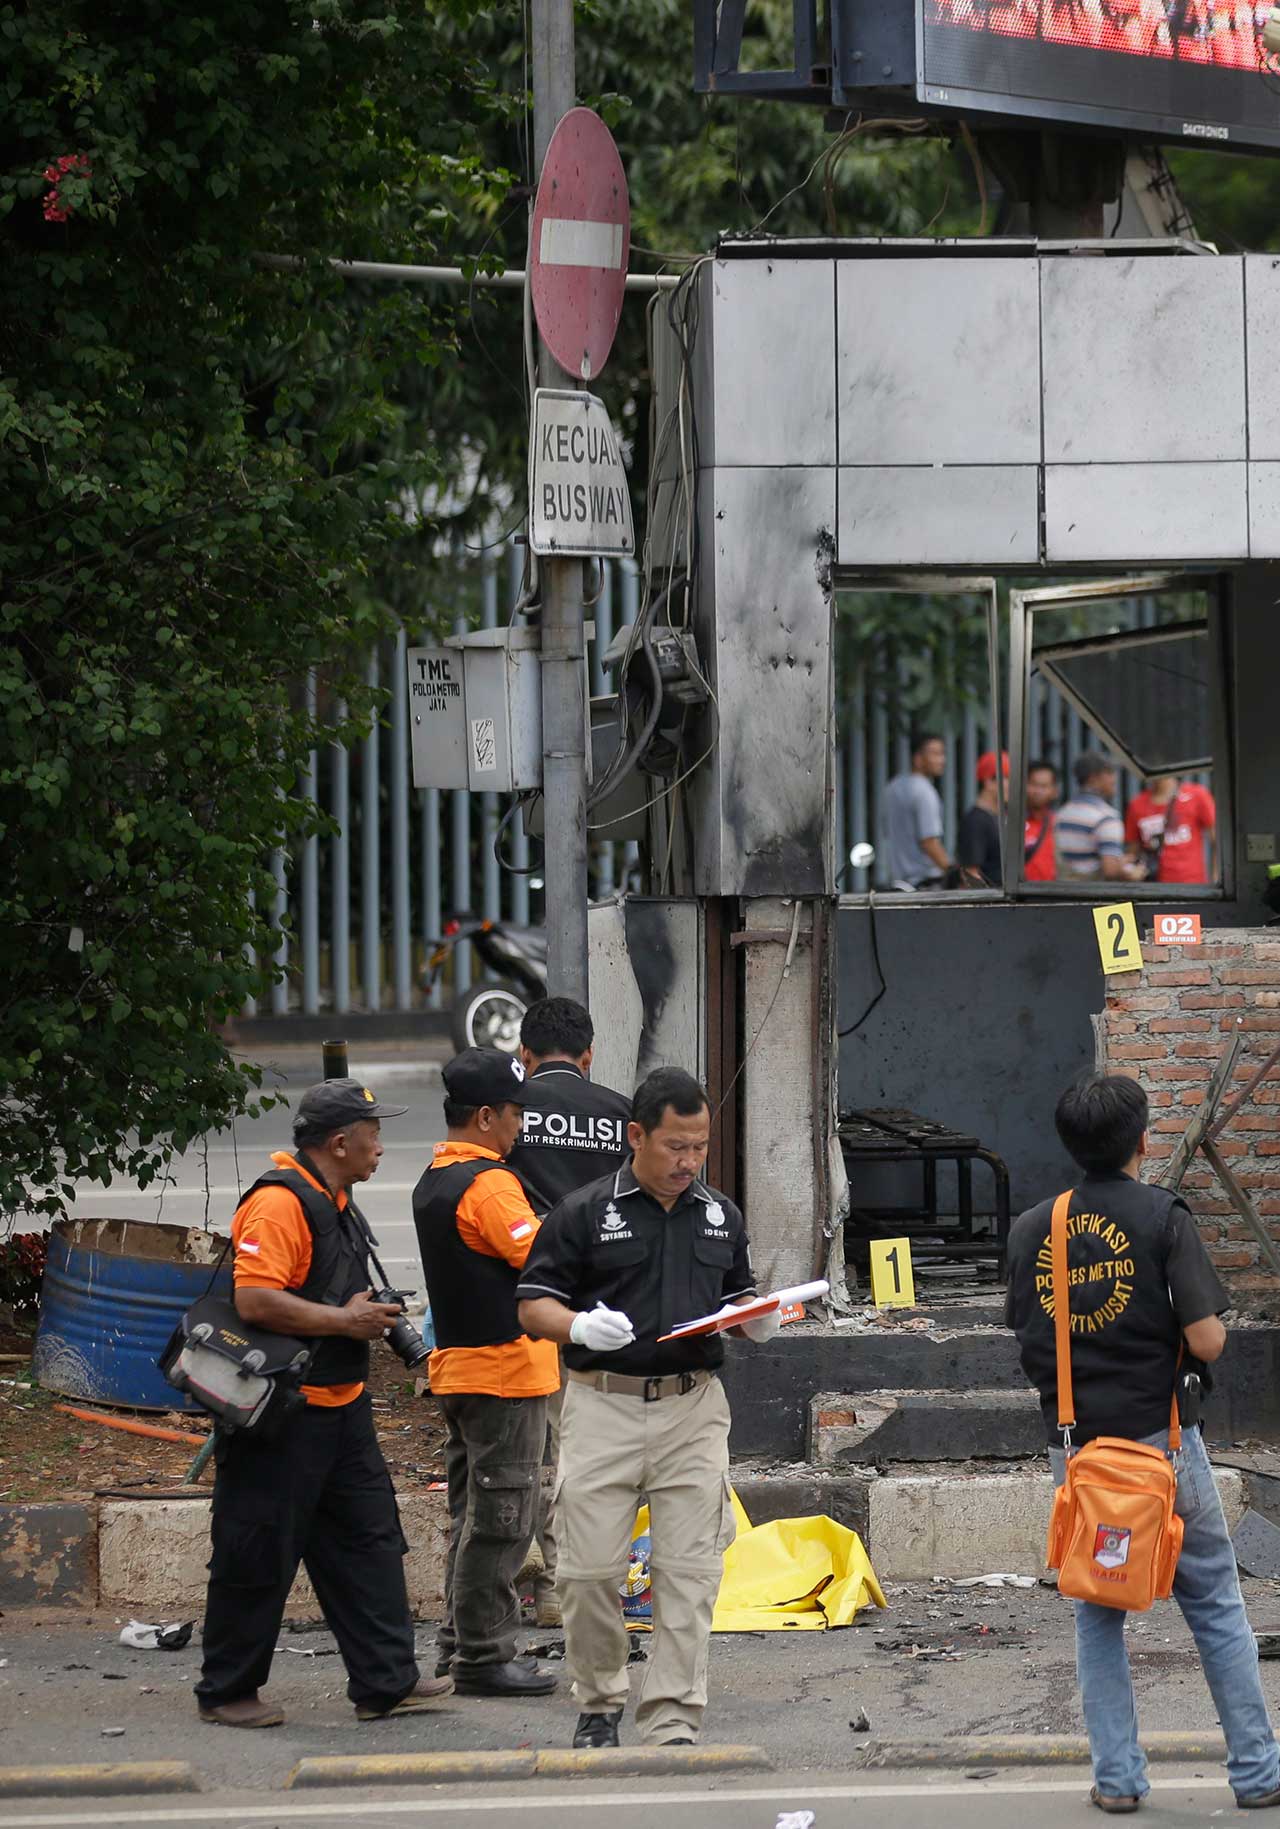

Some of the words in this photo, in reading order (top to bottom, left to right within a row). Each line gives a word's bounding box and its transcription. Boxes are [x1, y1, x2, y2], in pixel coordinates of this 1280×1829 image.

[543, 483, 625, 525] BUSWAY
[417, 658, 451, 681] TMC
[429, 698, 447, 712] JAYA
[1107, 913, 1129, 958] 2
[1161, 917, 1194, 935] 02
[522, 1111, 622, 1142] POLISI
[523, 1134, 540, 1143] DIT
[542, 1135, 599, 1149] RESKRIMUM
[601, 1142, 621, 1152] PMJ
[704, 1228, 729, 1238] IDENT
[885, 1247, 901, 1294] 1
[1088, 1258, 1135, 1283] METRO
[1094, 1279, 1134, 1329] PUSAT
